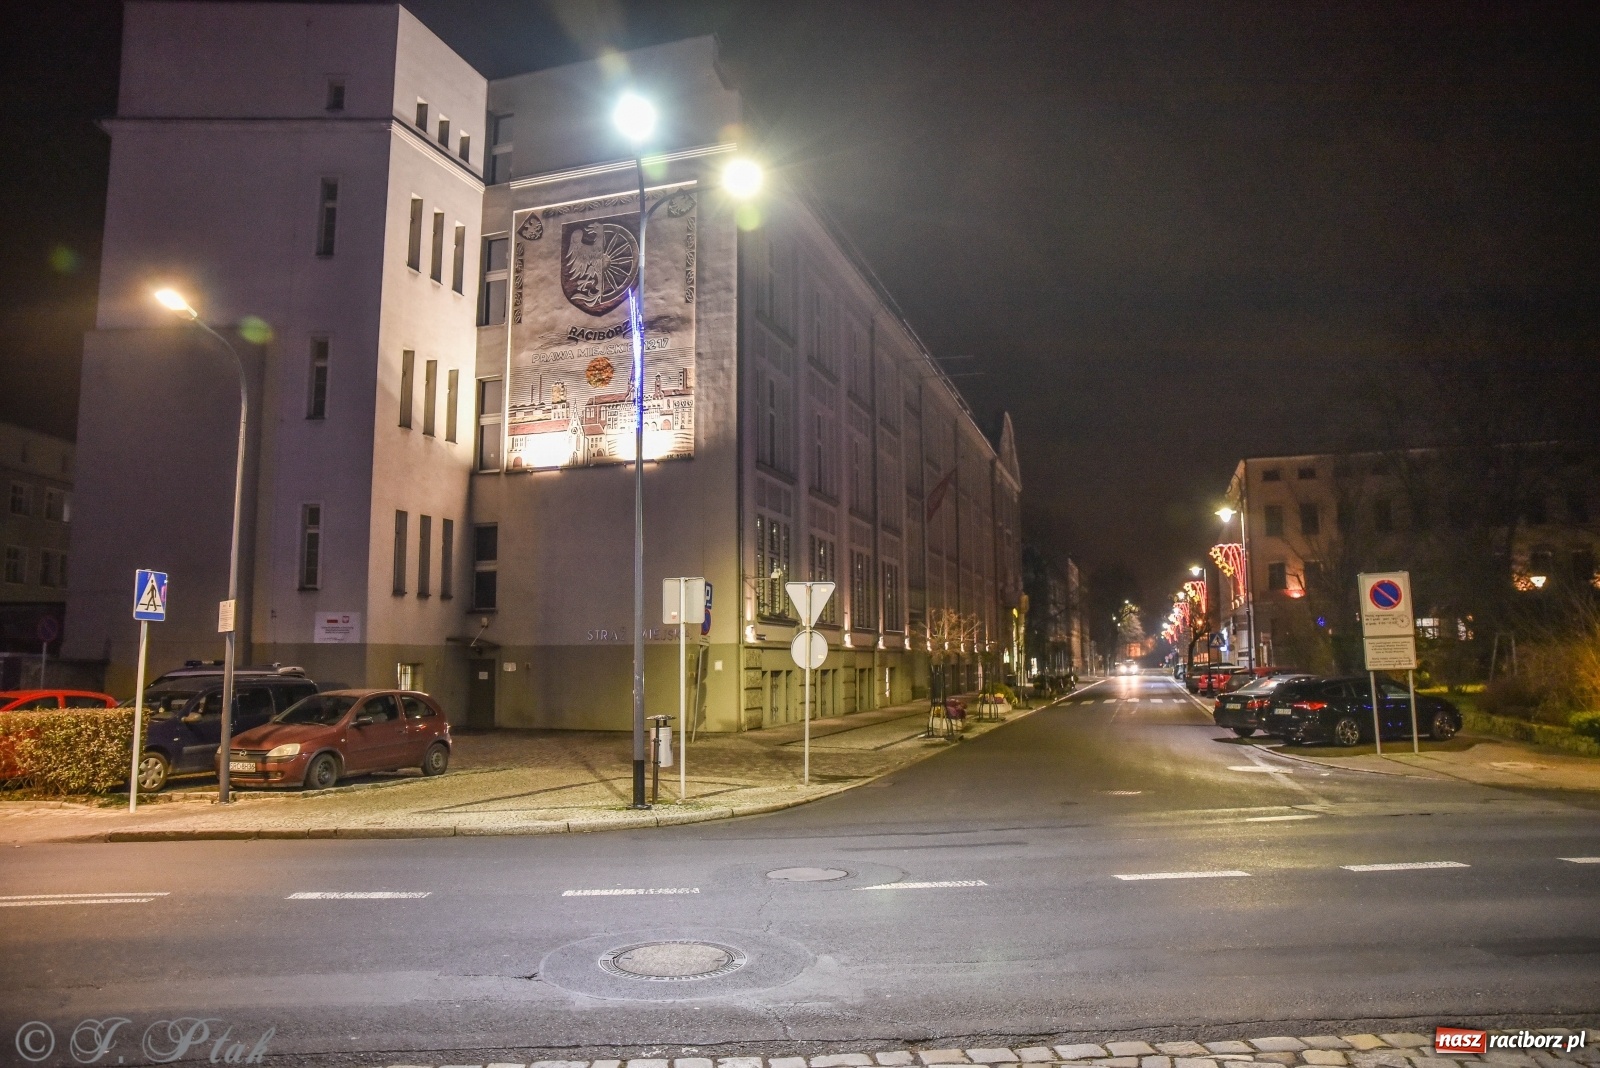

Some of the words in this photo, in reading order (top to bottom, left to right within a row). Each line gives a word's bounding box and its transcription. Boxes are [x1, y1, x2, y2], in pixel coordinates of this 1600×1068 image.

[568, 319, 632, 341] RACIBÓRZ
[531, 350, 575, 364] PRAWA
[577, 340, 634, 358] MIEJSKIE
[644, 337, 669, 351] 1217
[587, 626, 626, 641] STRAŻ
